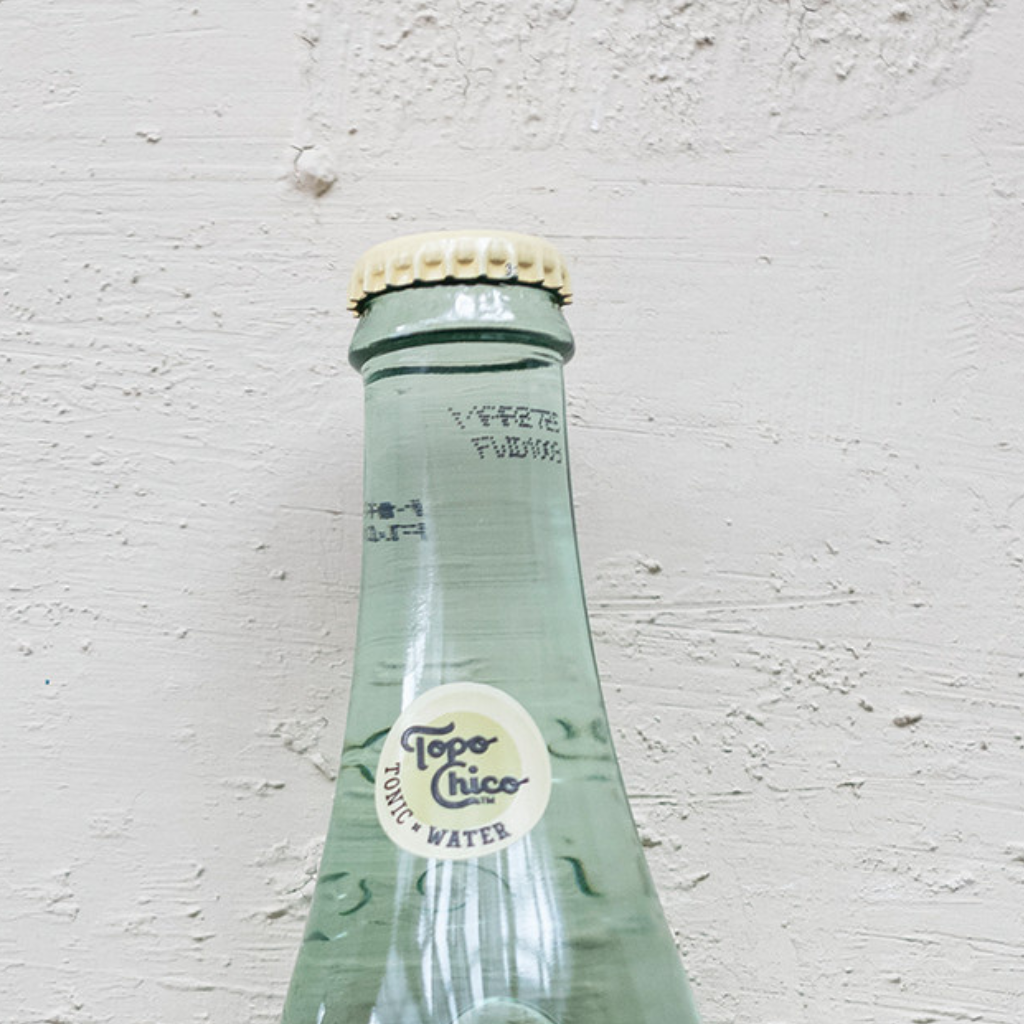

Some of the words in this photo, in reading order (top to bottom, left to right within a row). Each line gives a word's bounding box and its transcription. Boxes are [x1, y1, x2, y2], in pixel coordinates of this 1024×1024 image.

[401, 722, 497, 770] Topo
[384, 762, 413, 825] TONIC
[427, 821, 511, 848] WATER
[431, 760, 529, 809] Chico
